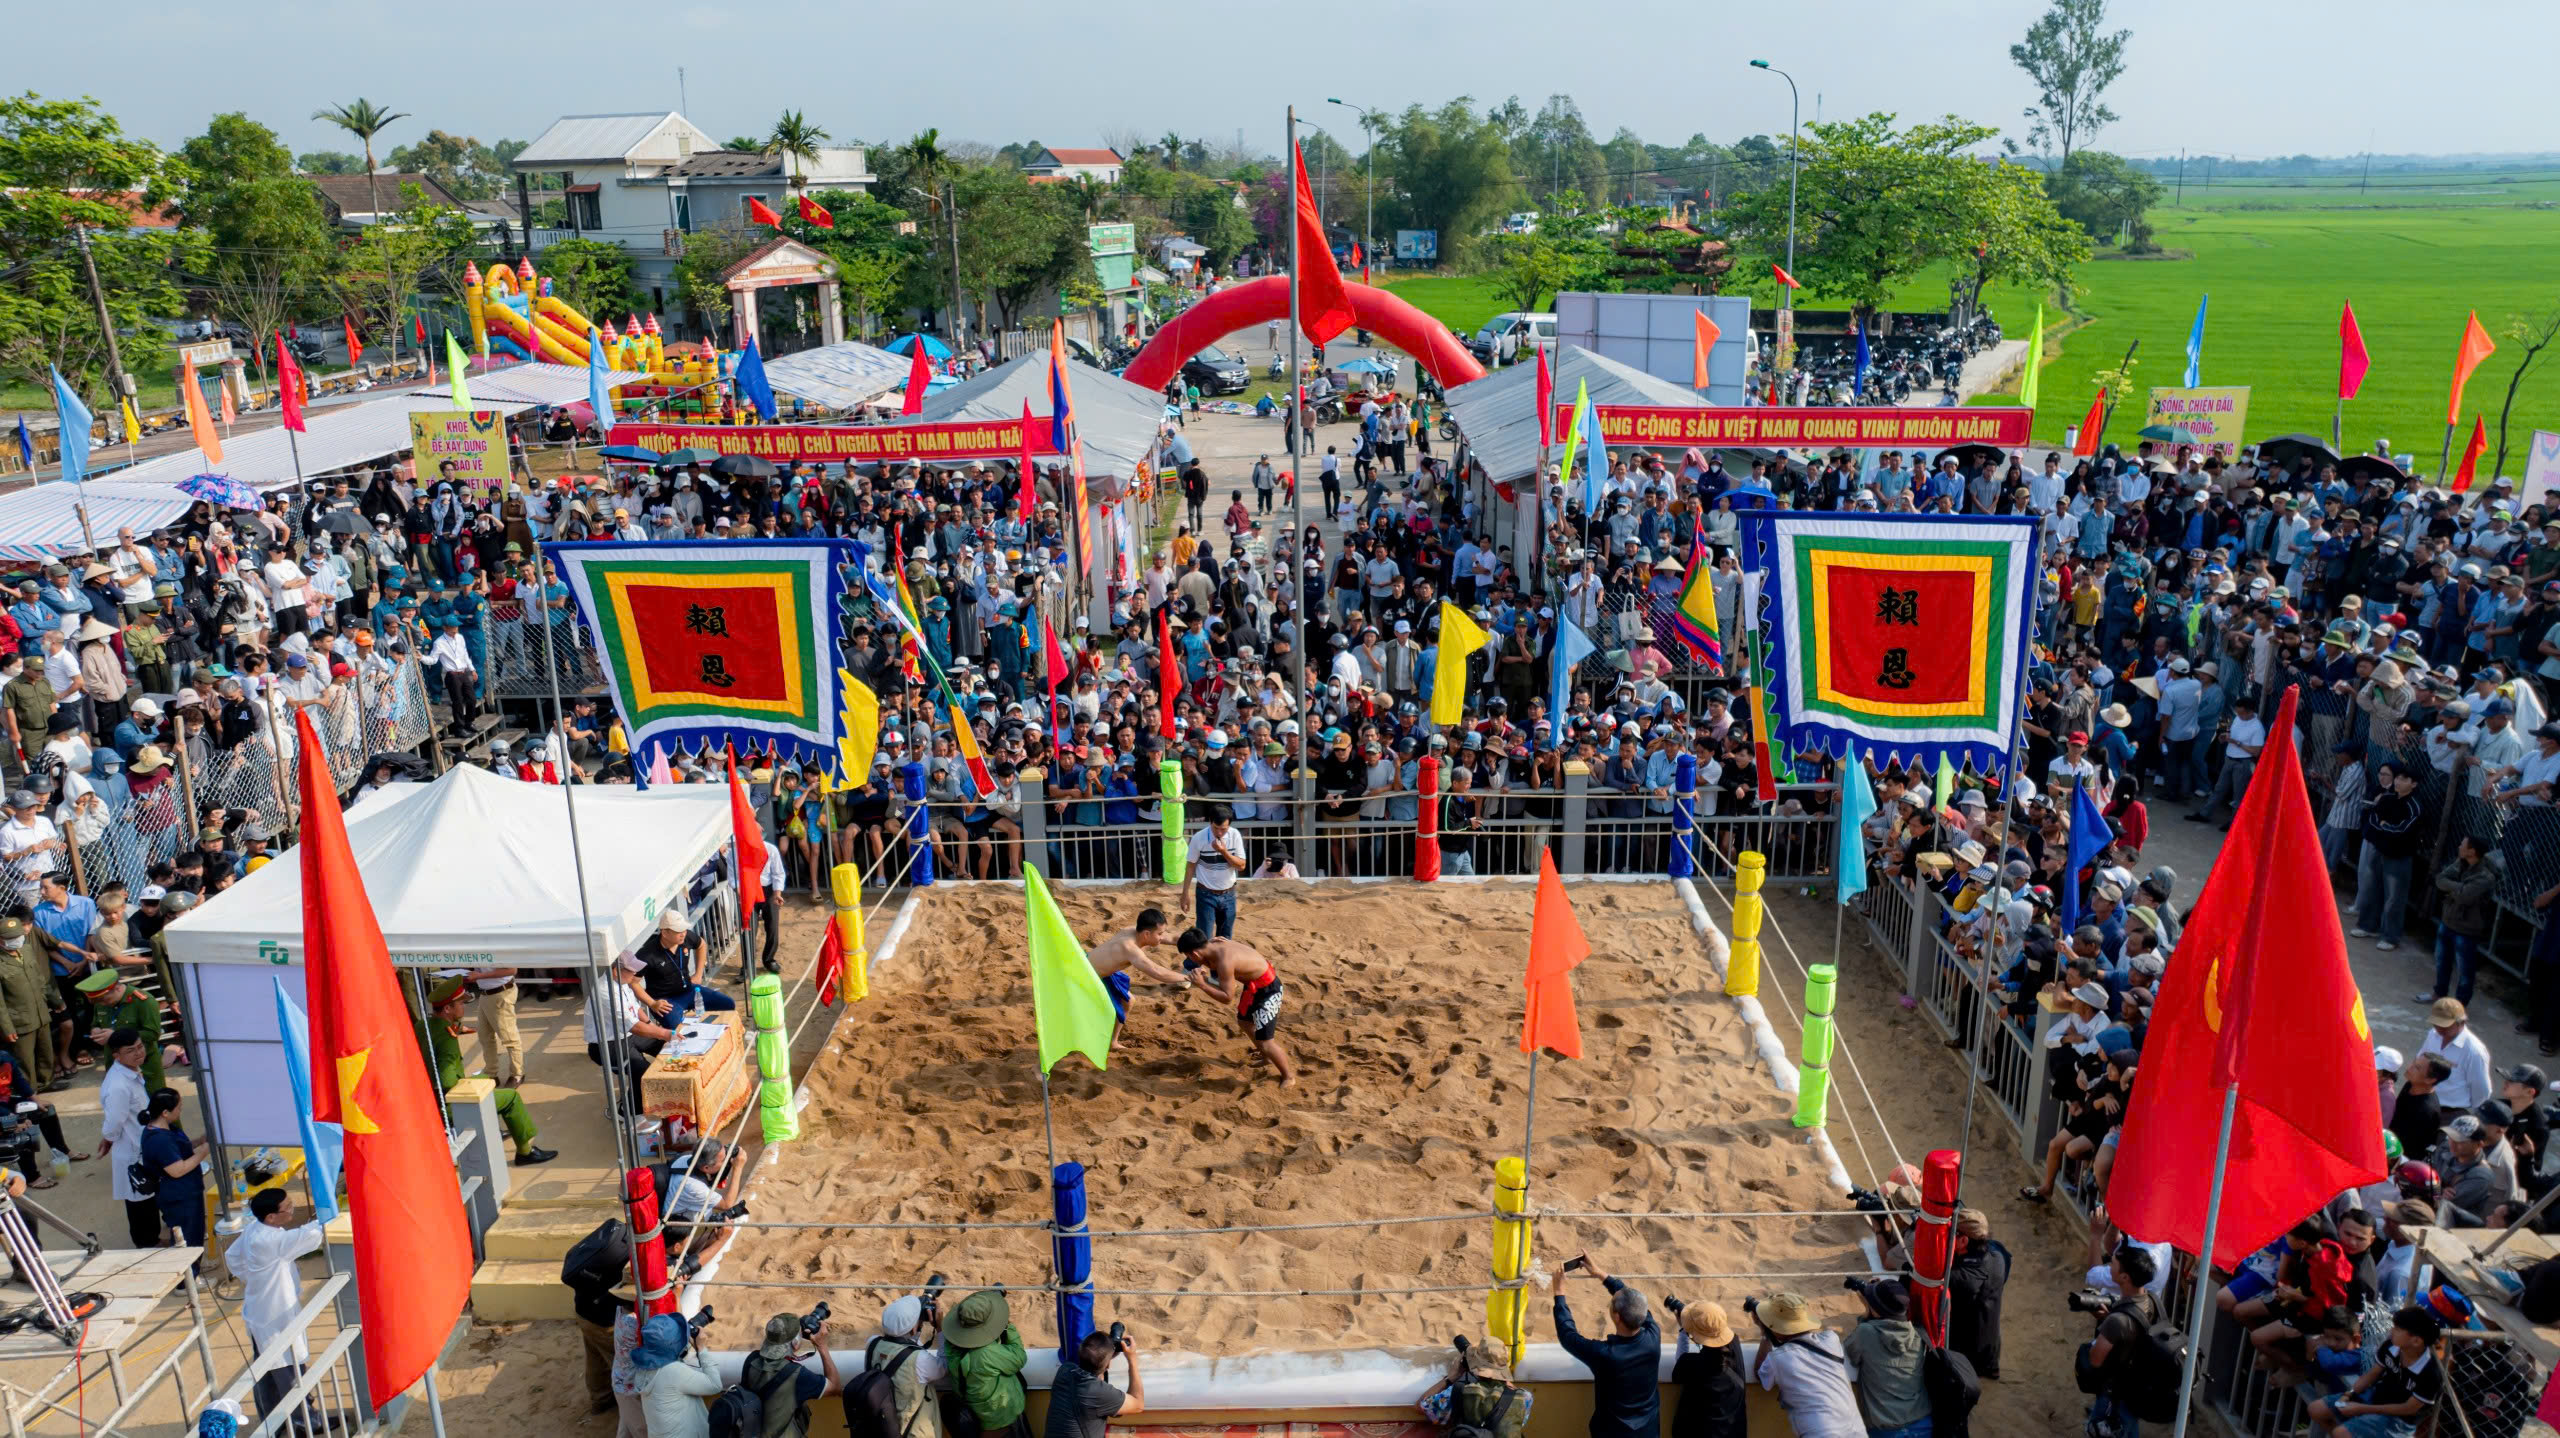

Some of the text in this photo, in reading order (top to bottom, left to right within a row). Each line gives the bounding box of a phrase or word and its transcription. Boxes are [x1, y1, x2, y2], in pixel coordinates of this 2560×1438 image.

[2188, 396, 2214, 413] CHIẾN
[1600, 411, 2001, 442] ẢNG CỘNG SẢN VIỆT NAM QUANG VINH MUÔN NĂM!
[753, 431, 773, 454] XÃ
[776, 432, 800, 458] HỘI
[804, 430, 833, 454] CHỦ
[836, 431, 881, 453] NGHĨA
[882, 430, 913, 456] VIỆT
[916, 432, 950, 451] NAM
[954, 427, 997, 449] MUÔN
[1000, 427, 1023, 448] NĂ
[483, 478, 503, 490] NAM
